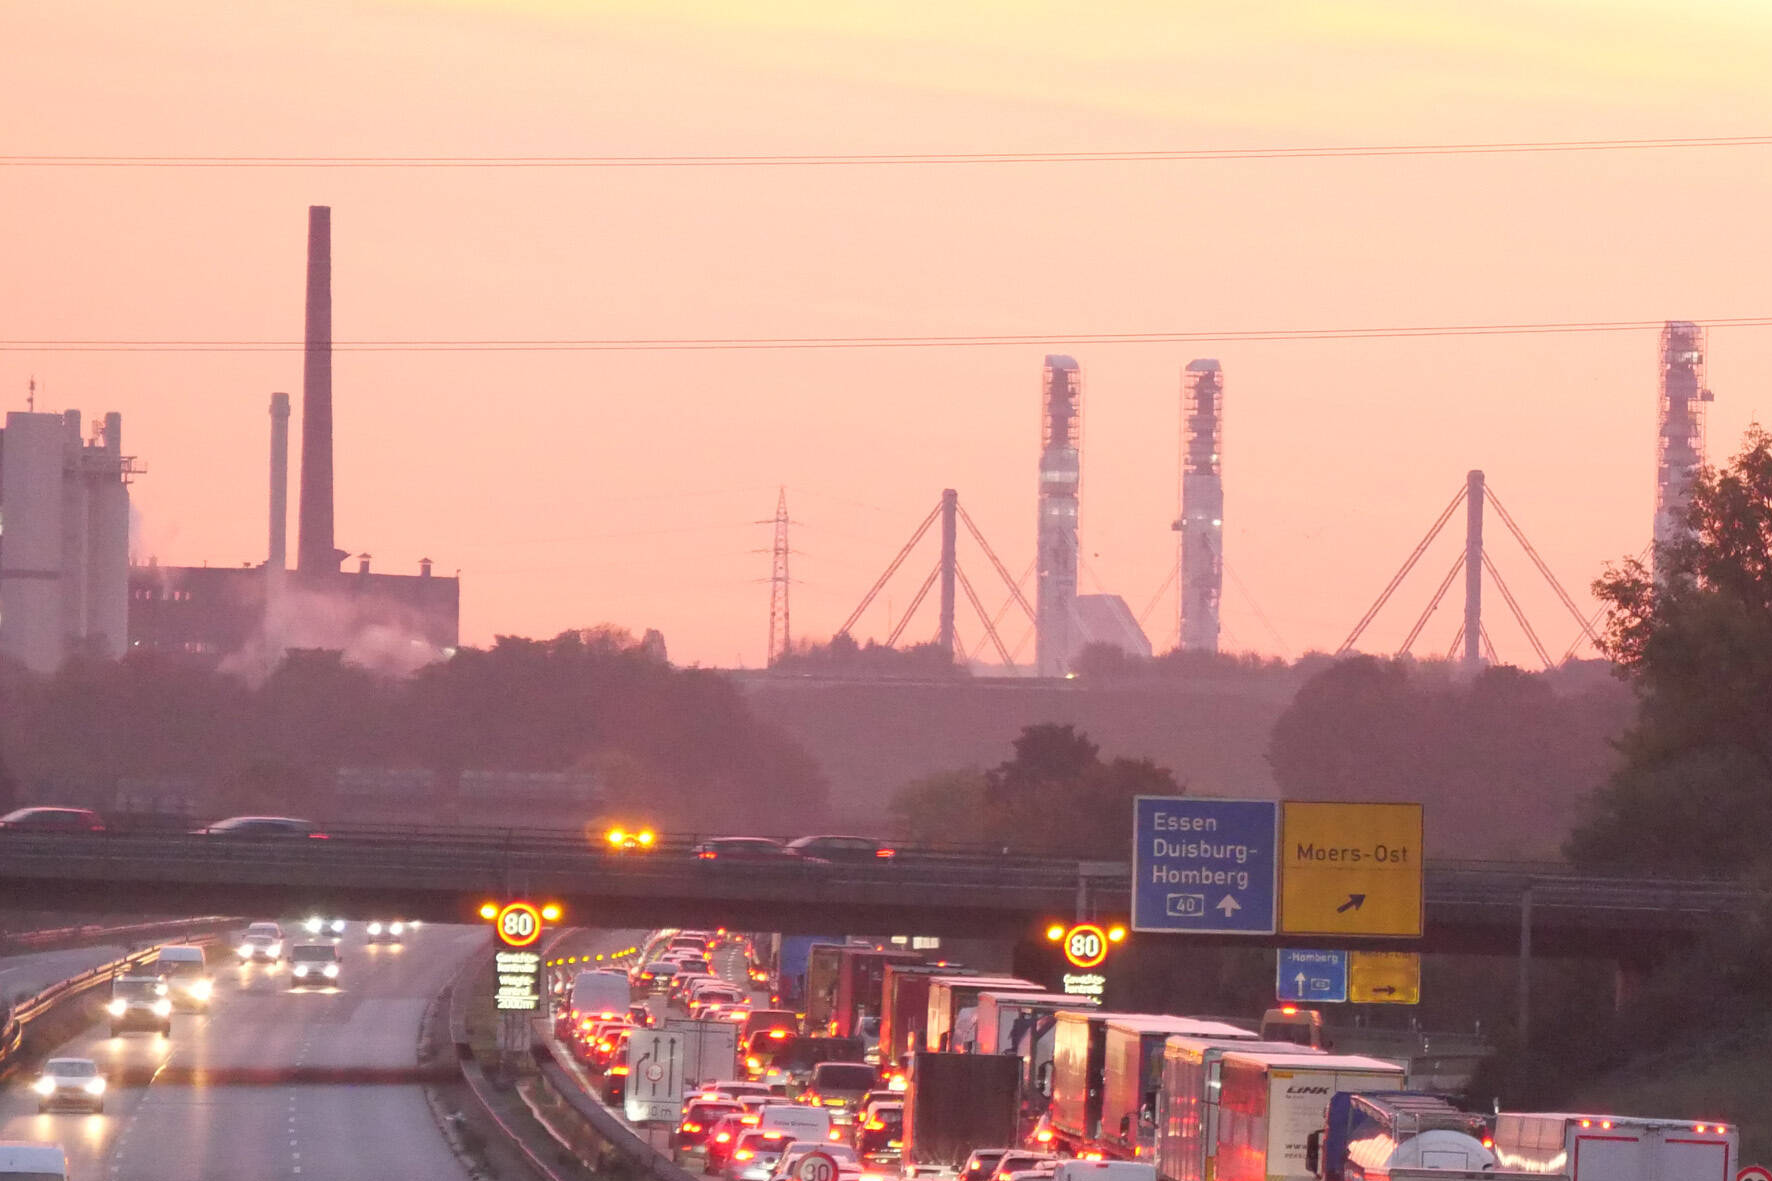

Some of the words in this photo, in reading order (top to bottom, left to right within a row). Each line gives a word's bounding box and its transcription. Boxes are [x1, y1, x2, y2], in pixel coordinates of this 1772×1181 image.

[1153, 811, 1217, 831] Essen
[1152, 838, 1258, 864] Duisburg-
[1296, 842, 1408, 863] Moers-Ost
[1151, 865, 1249, 890] Homberg
[1176, 897, 1196, 912] 40
[504, 912, 533, 936] 80
[1071, 934, 1099, 957] 80
[1286, 1086, 1331, 1095] LINK
